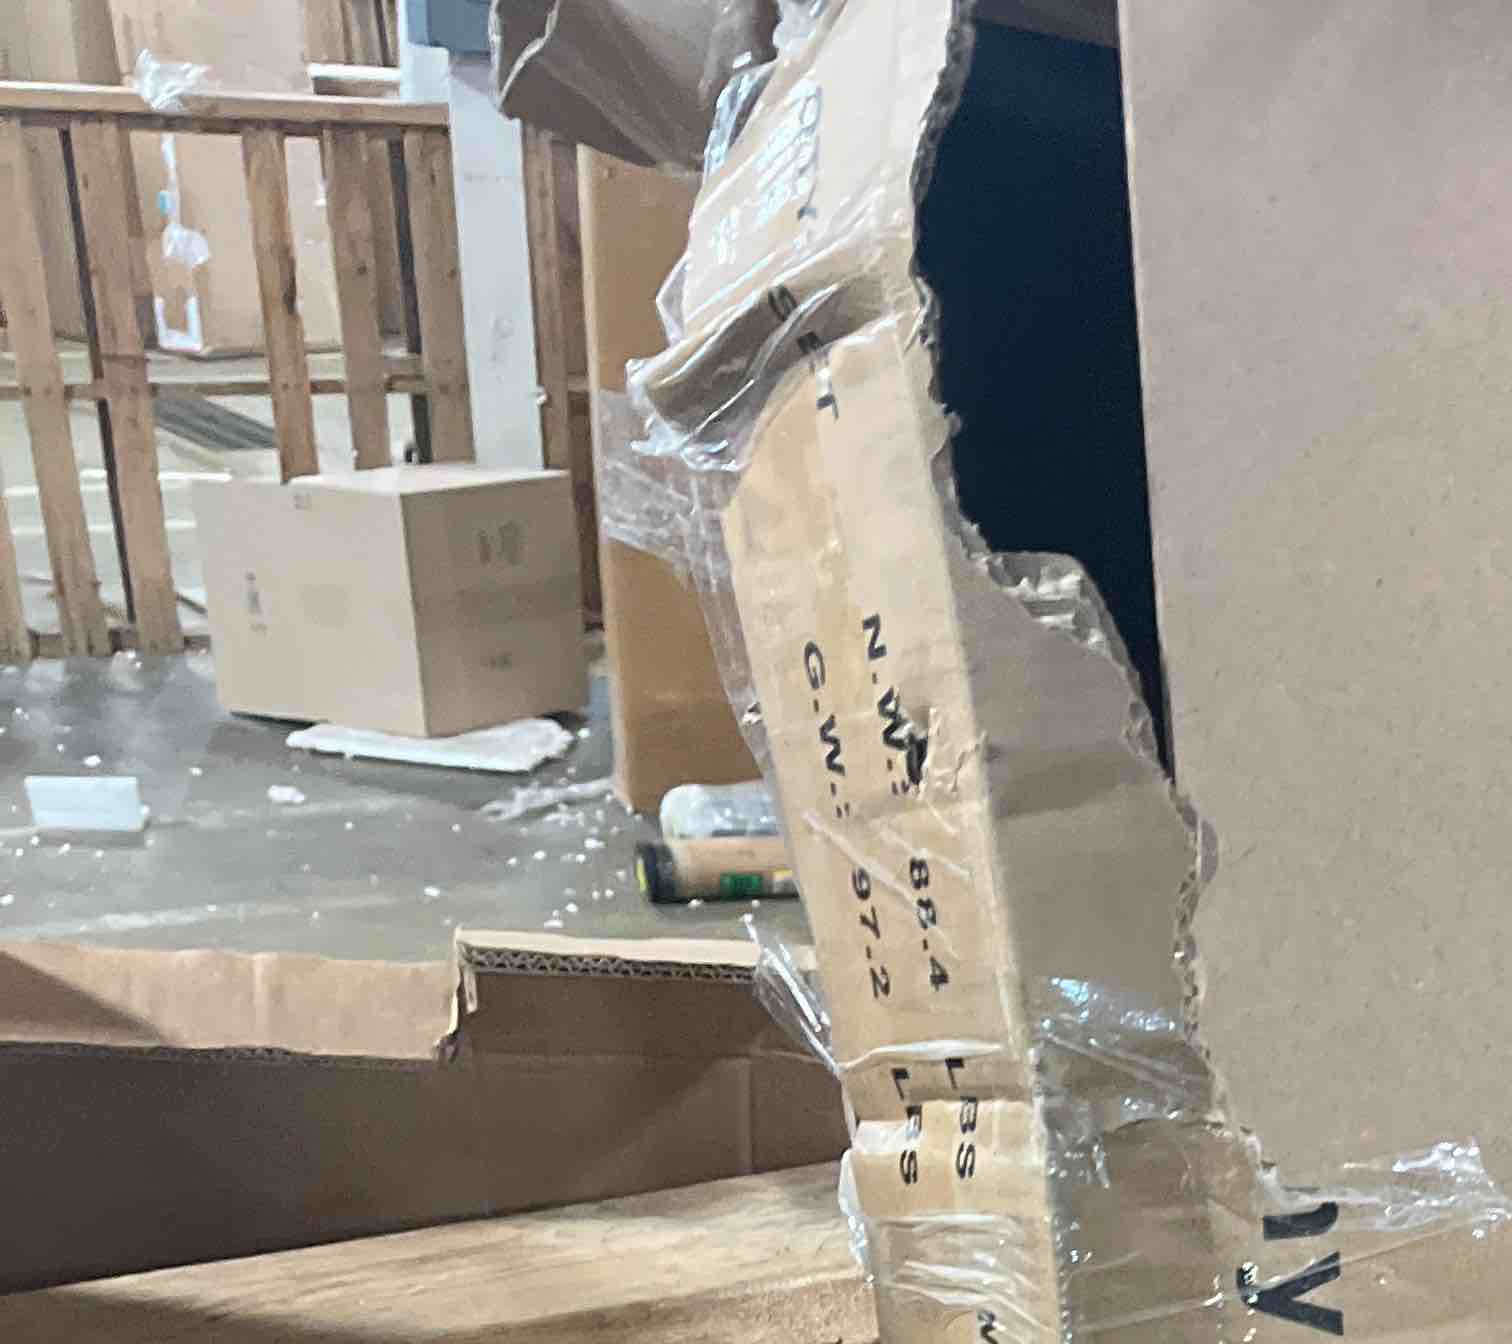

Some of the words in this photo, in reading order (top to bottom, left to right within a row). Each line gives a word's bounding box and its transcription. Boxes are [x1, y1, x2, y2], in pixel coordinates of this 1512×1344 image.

[804, 641, 851, 818] G.W.:
[852, 867, 891, 998] 97.2
[945, 1057, 978, 1180] LBS
